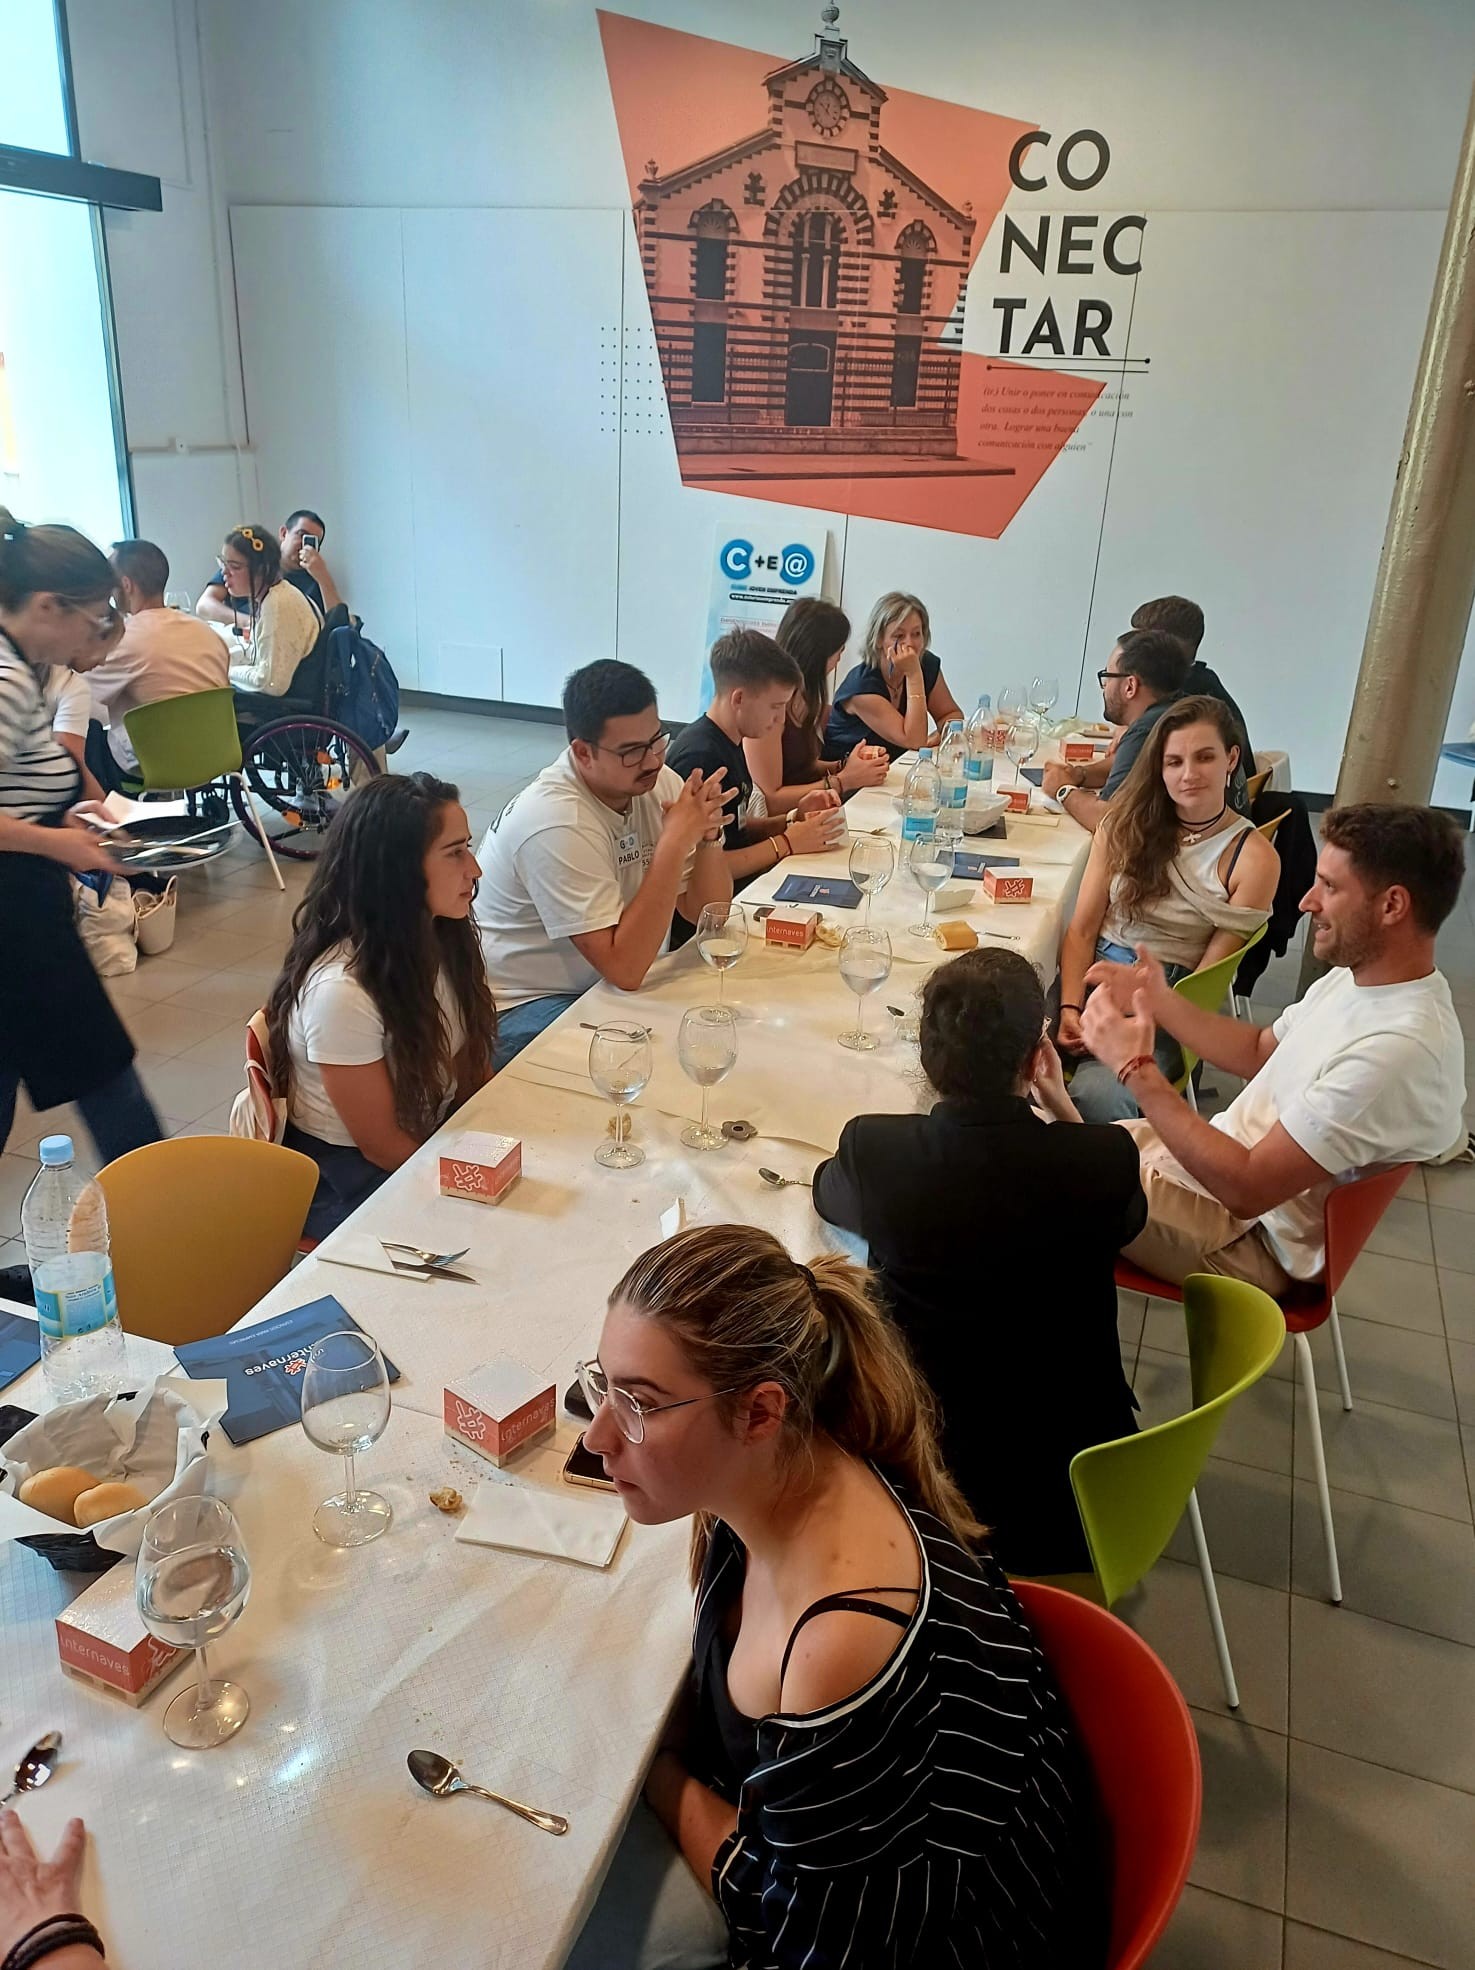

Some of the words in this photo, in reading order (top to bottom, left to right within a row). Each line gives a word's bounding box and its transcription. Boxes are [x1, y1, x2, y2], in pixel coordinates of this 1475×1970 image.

[1008, 129, 1111, 192] CO
[999, 213, 1148, 276] NEC
[992, 296, 1113, 356] TAR
[618, 850, 640, 865] PABLO
